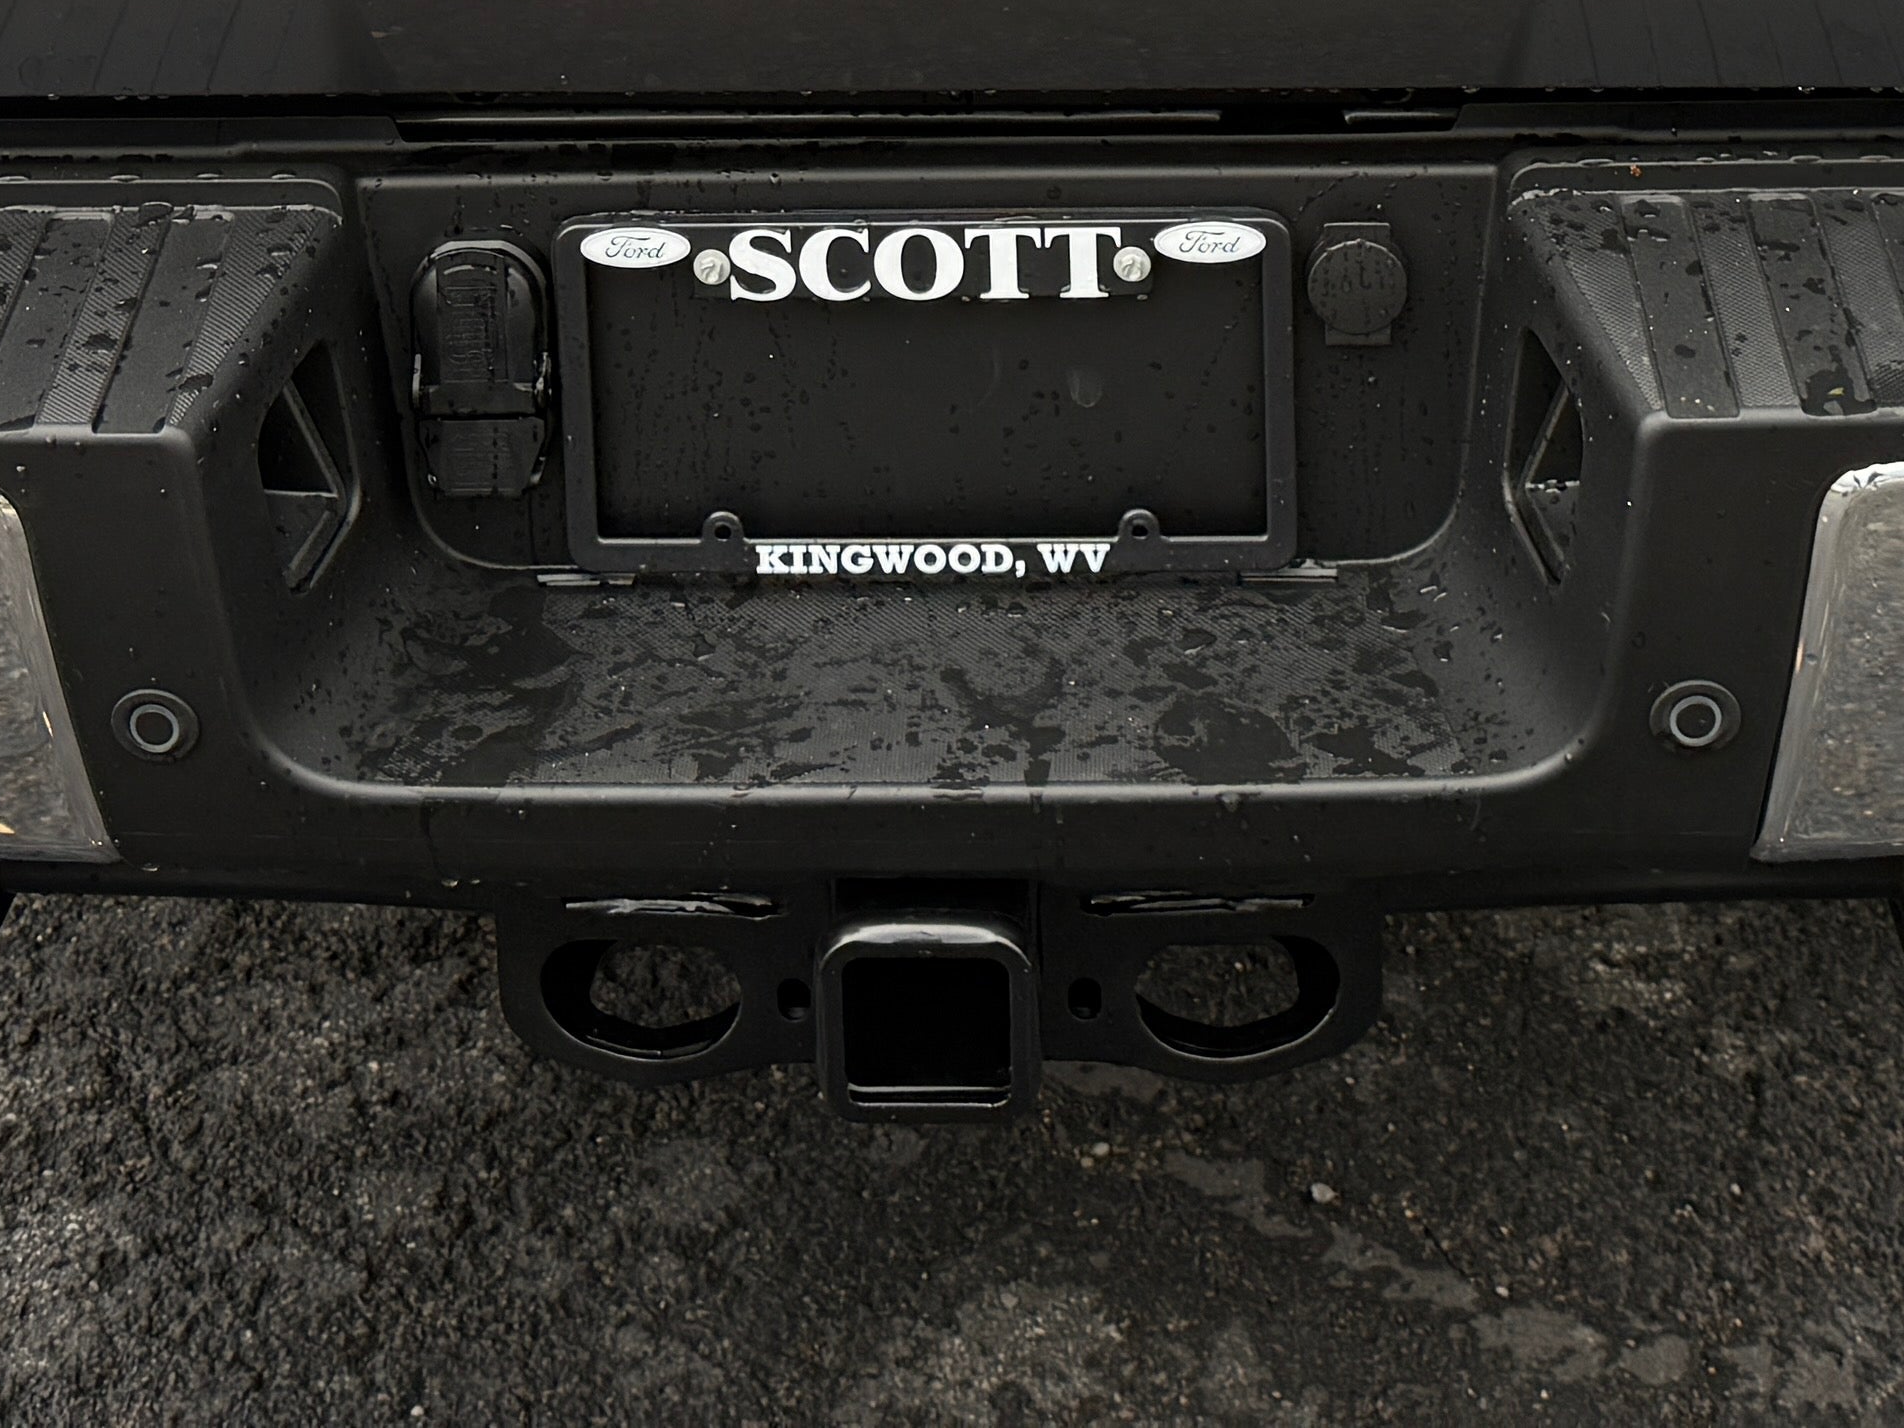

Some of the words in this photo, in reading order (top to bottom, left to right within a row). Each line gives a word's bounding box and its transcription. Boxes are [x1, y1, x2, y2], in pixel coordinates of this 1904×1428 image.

[604, 234, 667, 260] Ford
[1178, 229, 1241, 254] Ford
[728, 226, 1122, 302] SCOTT
[755, 543, 1027, 579] KINGWOOD,
[1036, 542, 1111, 575] WV
